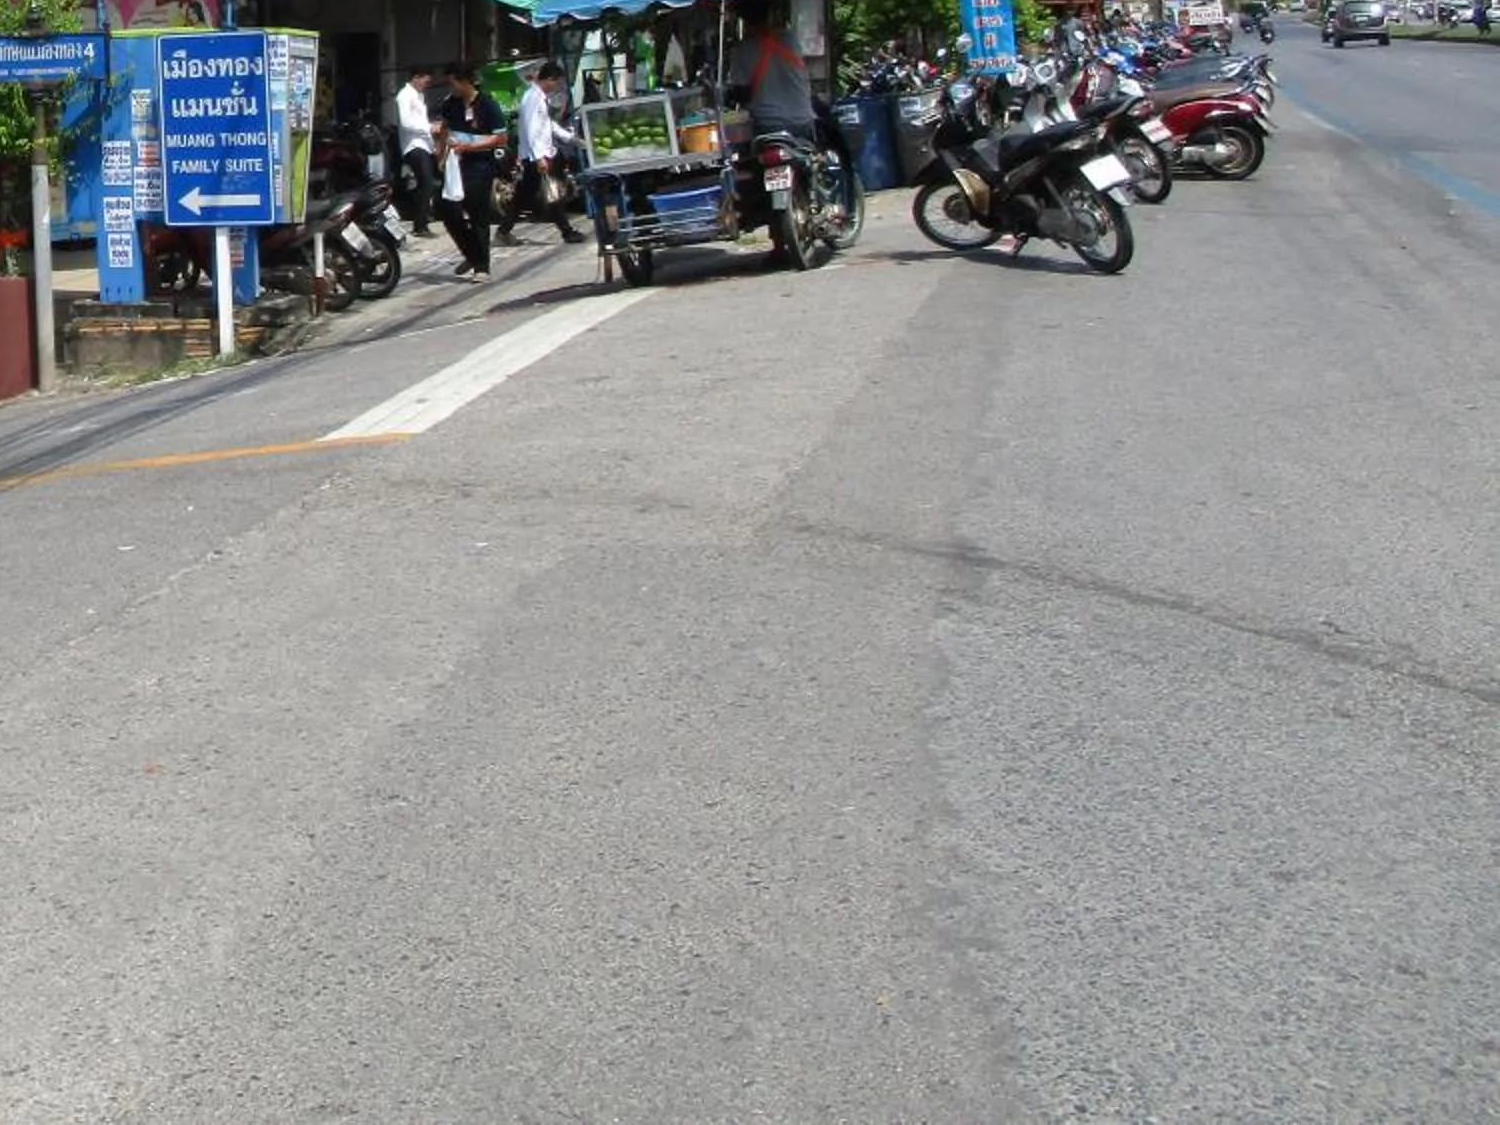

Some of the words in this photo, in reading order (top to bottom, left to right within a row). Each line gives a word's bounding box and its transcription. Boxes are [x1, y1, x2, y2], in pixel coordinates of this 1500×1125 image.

[163, 48, 264, 81] เมืองทอง
[171, 81, 258, 119] แมนชั่น
[166, 132, 215, 148] MUANG
[219, 131, 267, 147] THONG
[171, 158, 219, 174] FAMILY
[225, 157, 264, 173] SUITE
